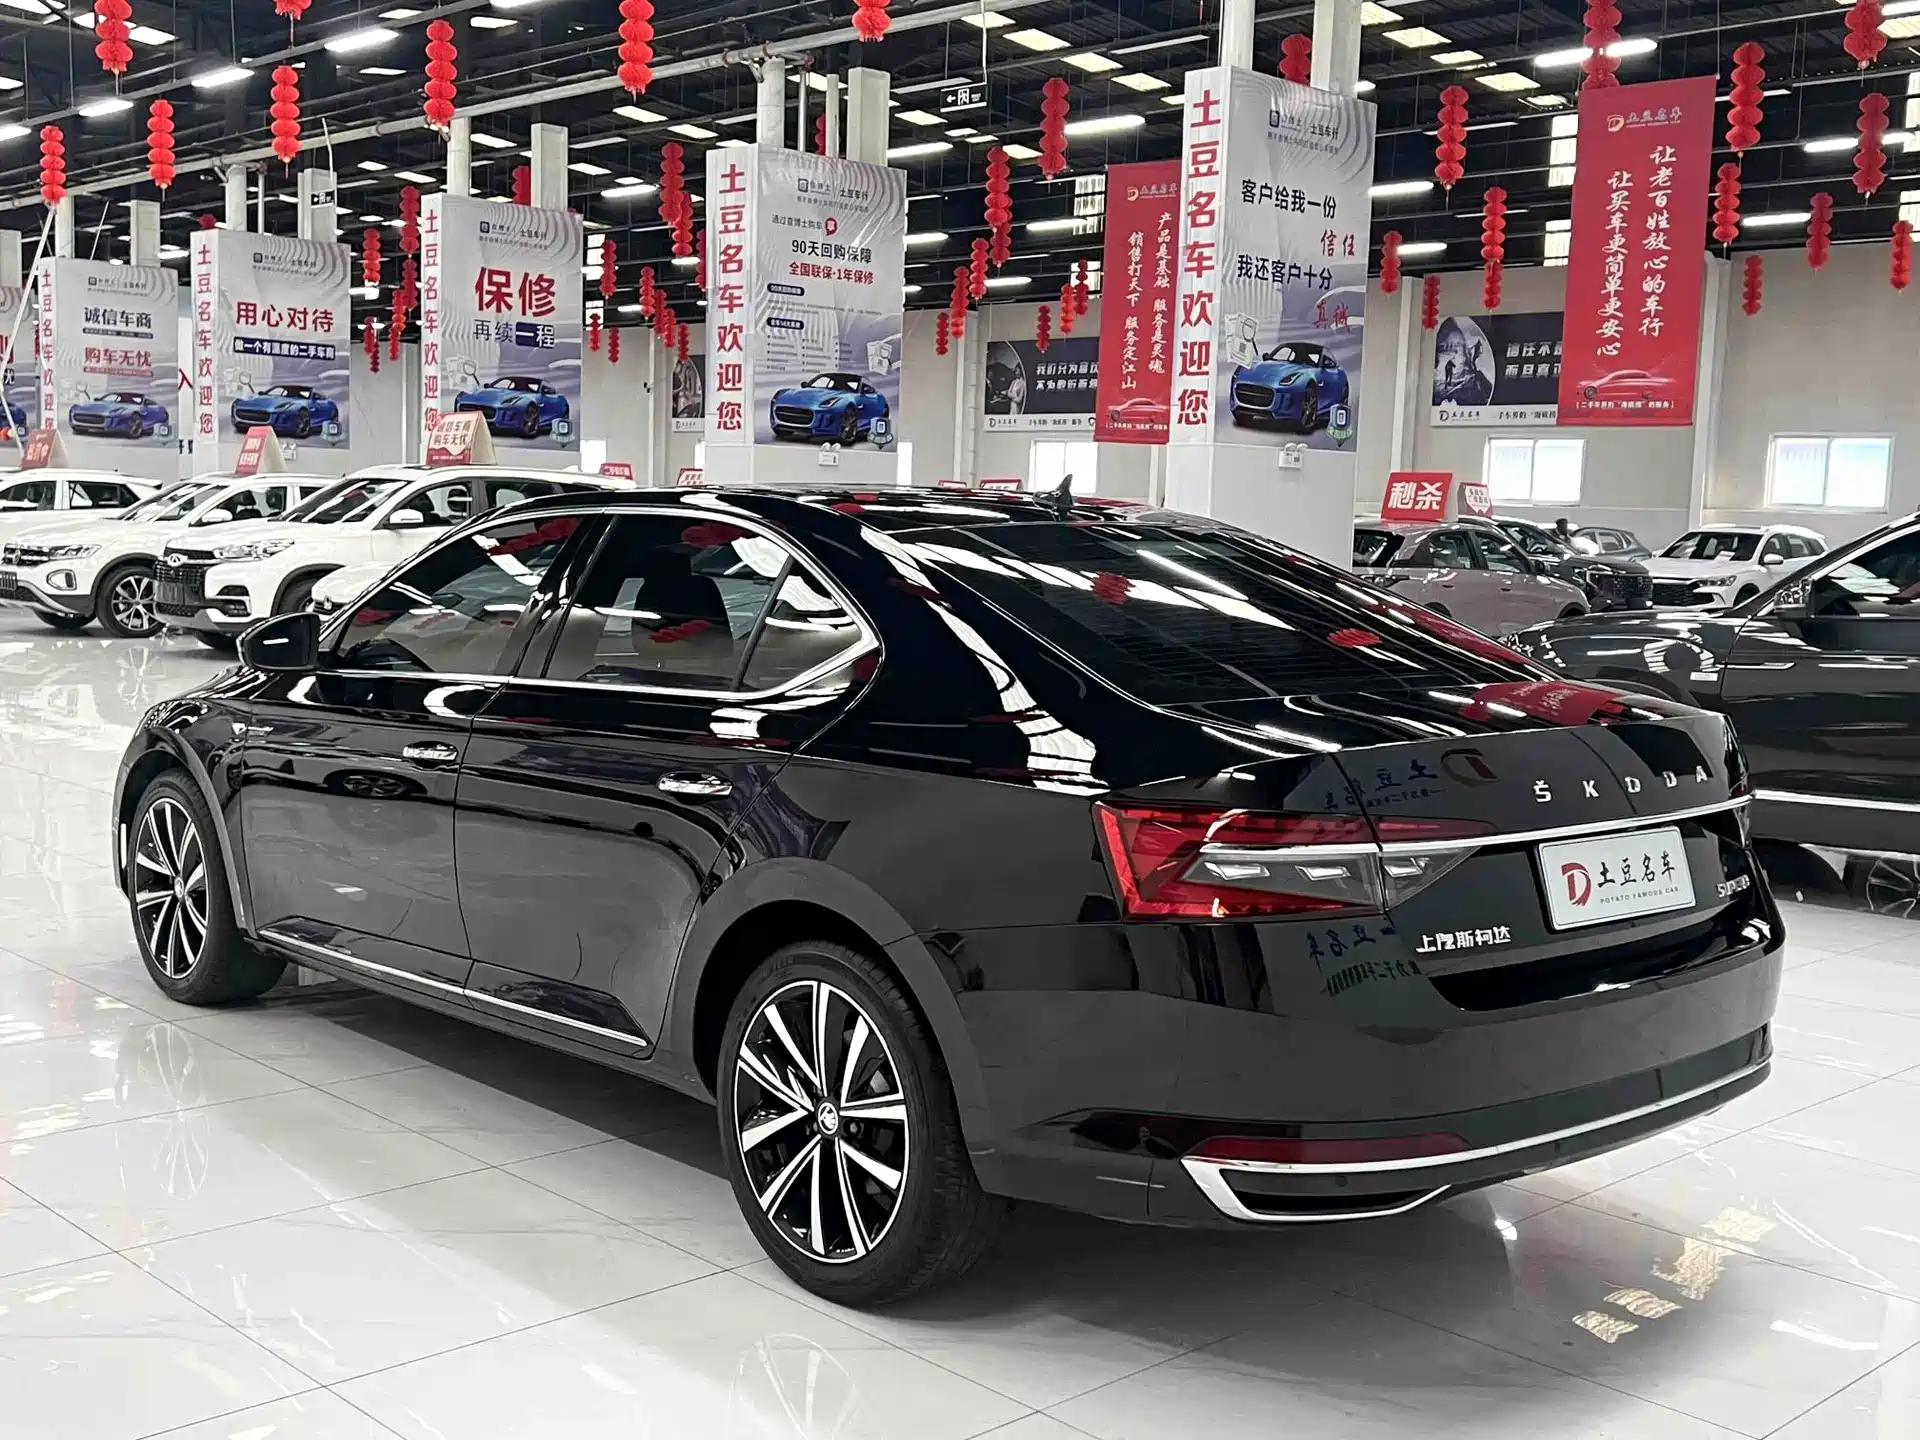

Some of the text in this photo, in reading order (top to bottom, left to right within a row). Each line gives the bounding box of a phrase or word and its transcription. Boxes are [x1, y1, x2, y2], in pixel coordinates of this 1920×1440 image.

[1241, 179, 1337, 219] 客户给我一份
[791, 239, 872, 264] 90天回购保障
[1153, 211, 1172, 289] 产品是基础
[1177, 89, 1222, 425] 土豆名车欢迎您
[1321, 229, 1355, 257] 信任
[1638, 145, 1677, 337] 让老百姓放心的车行
[1238, 254, 1333, 290] 我还客户十分
[1596, 170, 1633, 356] 让买车更简单更安心
[475, 266, 556, 318] 保修
[716, 163, 745, 430] 土豆名车欢迎您
[1121, 231, 1144, 389] 销售打天下 服务定江山
[84, 307, 152, 329] 诚信车商
[236, 301, 334, 333] 用心对待
[423, 209, 440, 432] 土豆名车欢迎您
[473, 319, 555, 348] 再续一程
[1148, 298, 1168, 374] 服务是灵魂
[84, 347, 152, 367] 购车无忧
[197, 244, 214, 434] 土豆名车欢迎您
[234, 338, 335, 360] 做一个有温度的二手车商
[1388, 481, 1443, 510] 秒杀
[1598, 850, 1675, 888] 土豆名车
[1600, 894, 1630, 904] POTATO
[1632, 888, 1663, 898] FAMOUS
